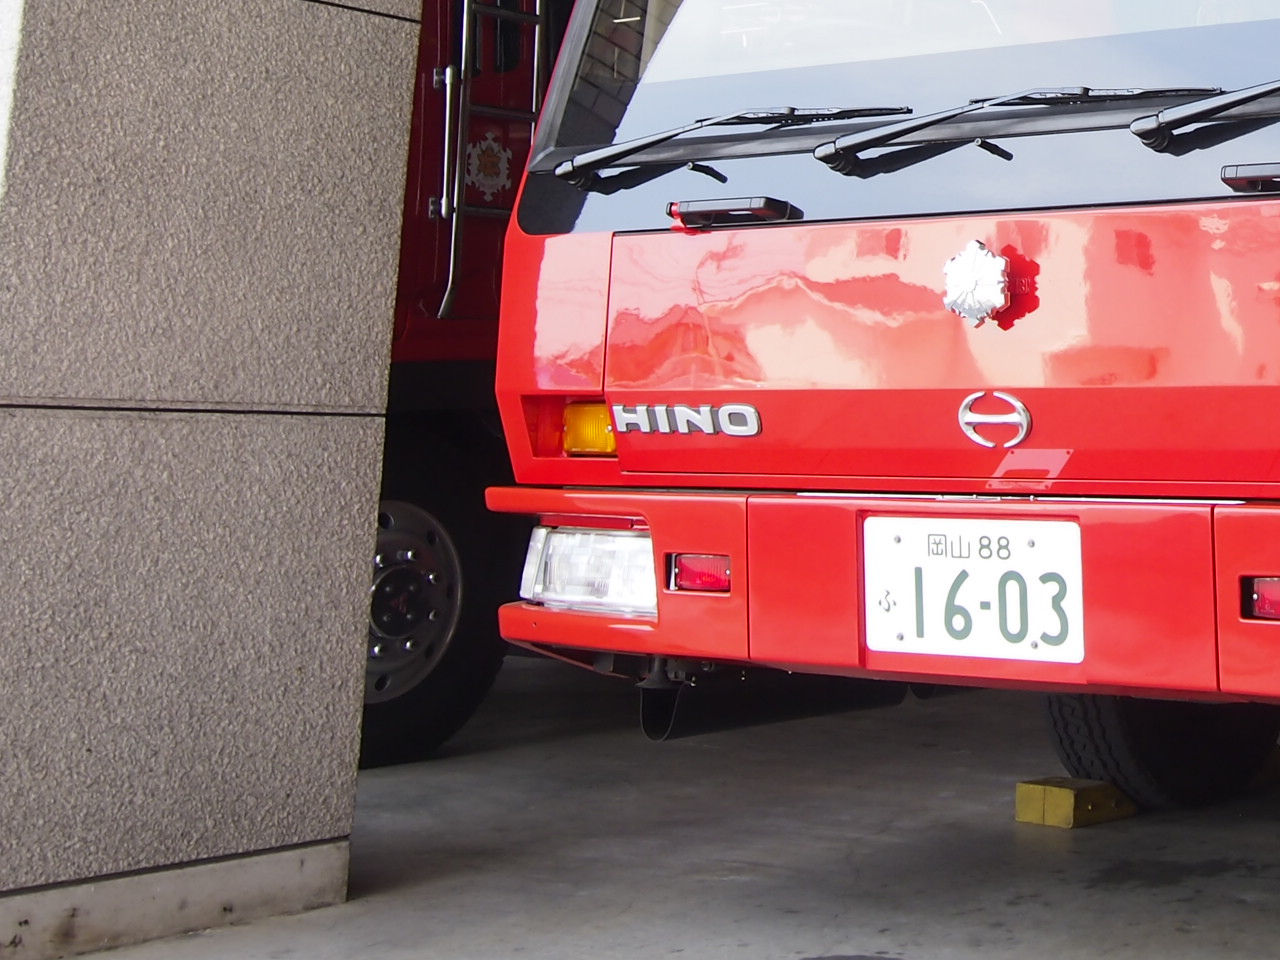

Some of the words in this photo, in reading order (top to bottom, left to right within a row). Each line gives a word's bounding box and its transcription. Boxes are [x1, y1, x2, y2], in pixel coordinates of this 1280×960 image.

[612, 403, 763, 437] HINO
[878, 589, 896, 612] ふ
[914, 566, 1069, 646] 16-03
